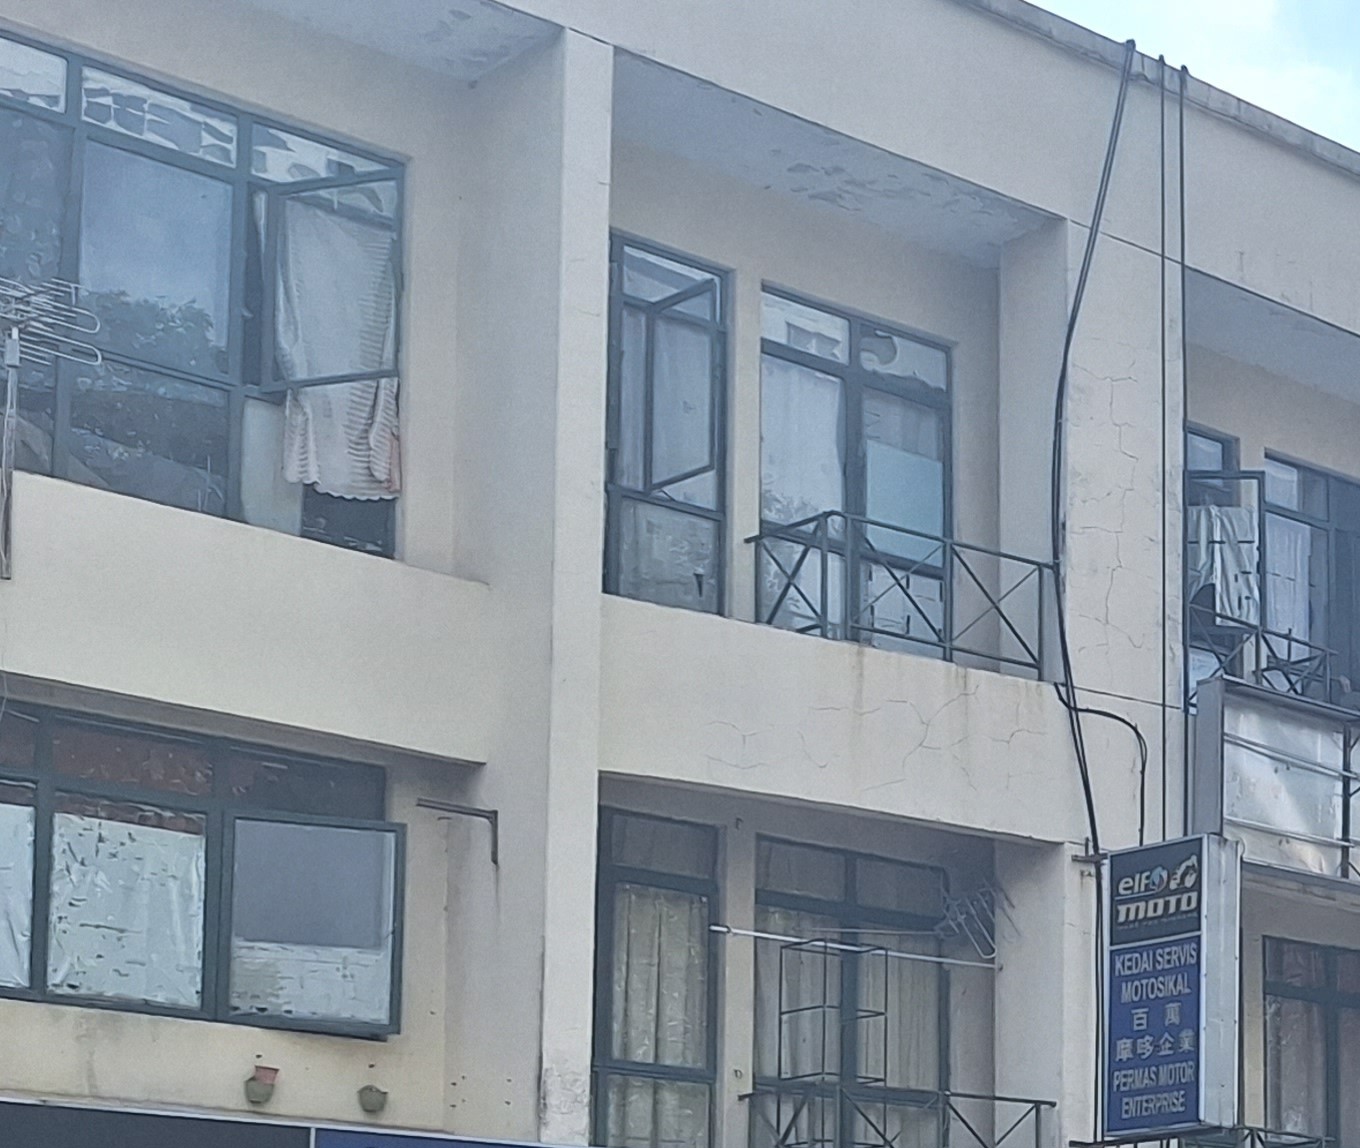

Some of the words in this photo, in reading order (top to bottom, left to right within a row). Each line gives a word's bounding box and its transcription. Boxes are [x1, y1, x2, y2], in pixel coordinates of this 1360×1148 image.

[1115, 953, 1153, 977] KEDAI
[1155, 942, 1198, 971] SERVIS
[1121, 972, 1192, 1003] MOTOSIKAL
[1113, 1066, 1157, 1092] PERMAS
[1158, 1060, 1195, 1087] MOTOR
[1121, 1090, 1186, 1119] ENTERPRISE
